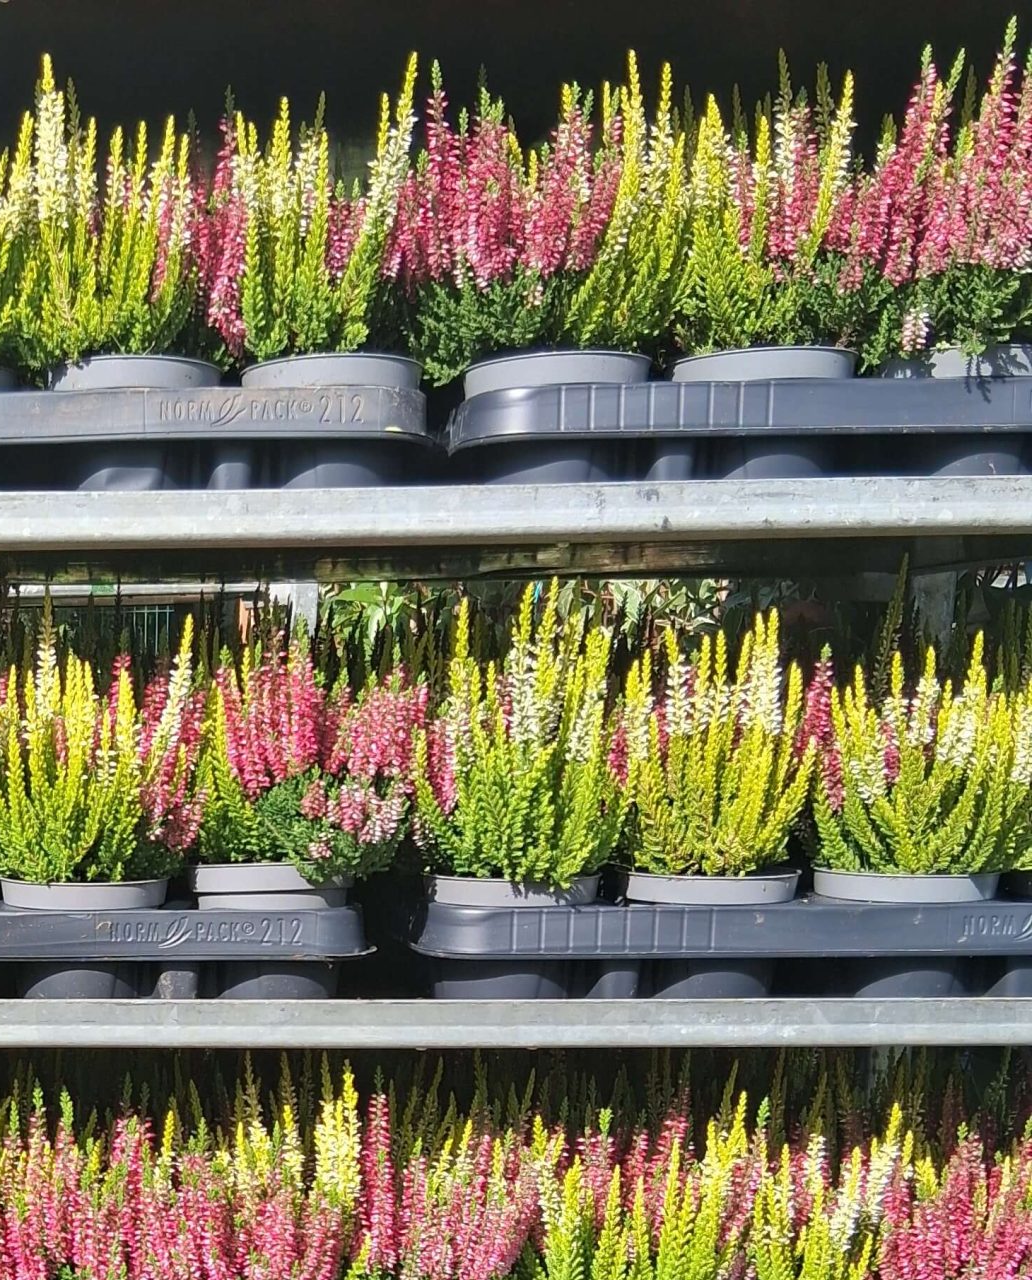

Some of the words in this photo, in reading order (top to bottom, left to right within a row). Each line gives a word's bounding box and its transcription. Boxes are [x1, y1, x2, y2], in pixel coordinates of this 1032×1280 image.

[159, 398, 216, 423] NORM
[319, 395, 365, 425] 212
[110, 921, 161, 943] NORM
[260, 917, 303, 946] 212
[962, 914, 1017, 936] NORM
